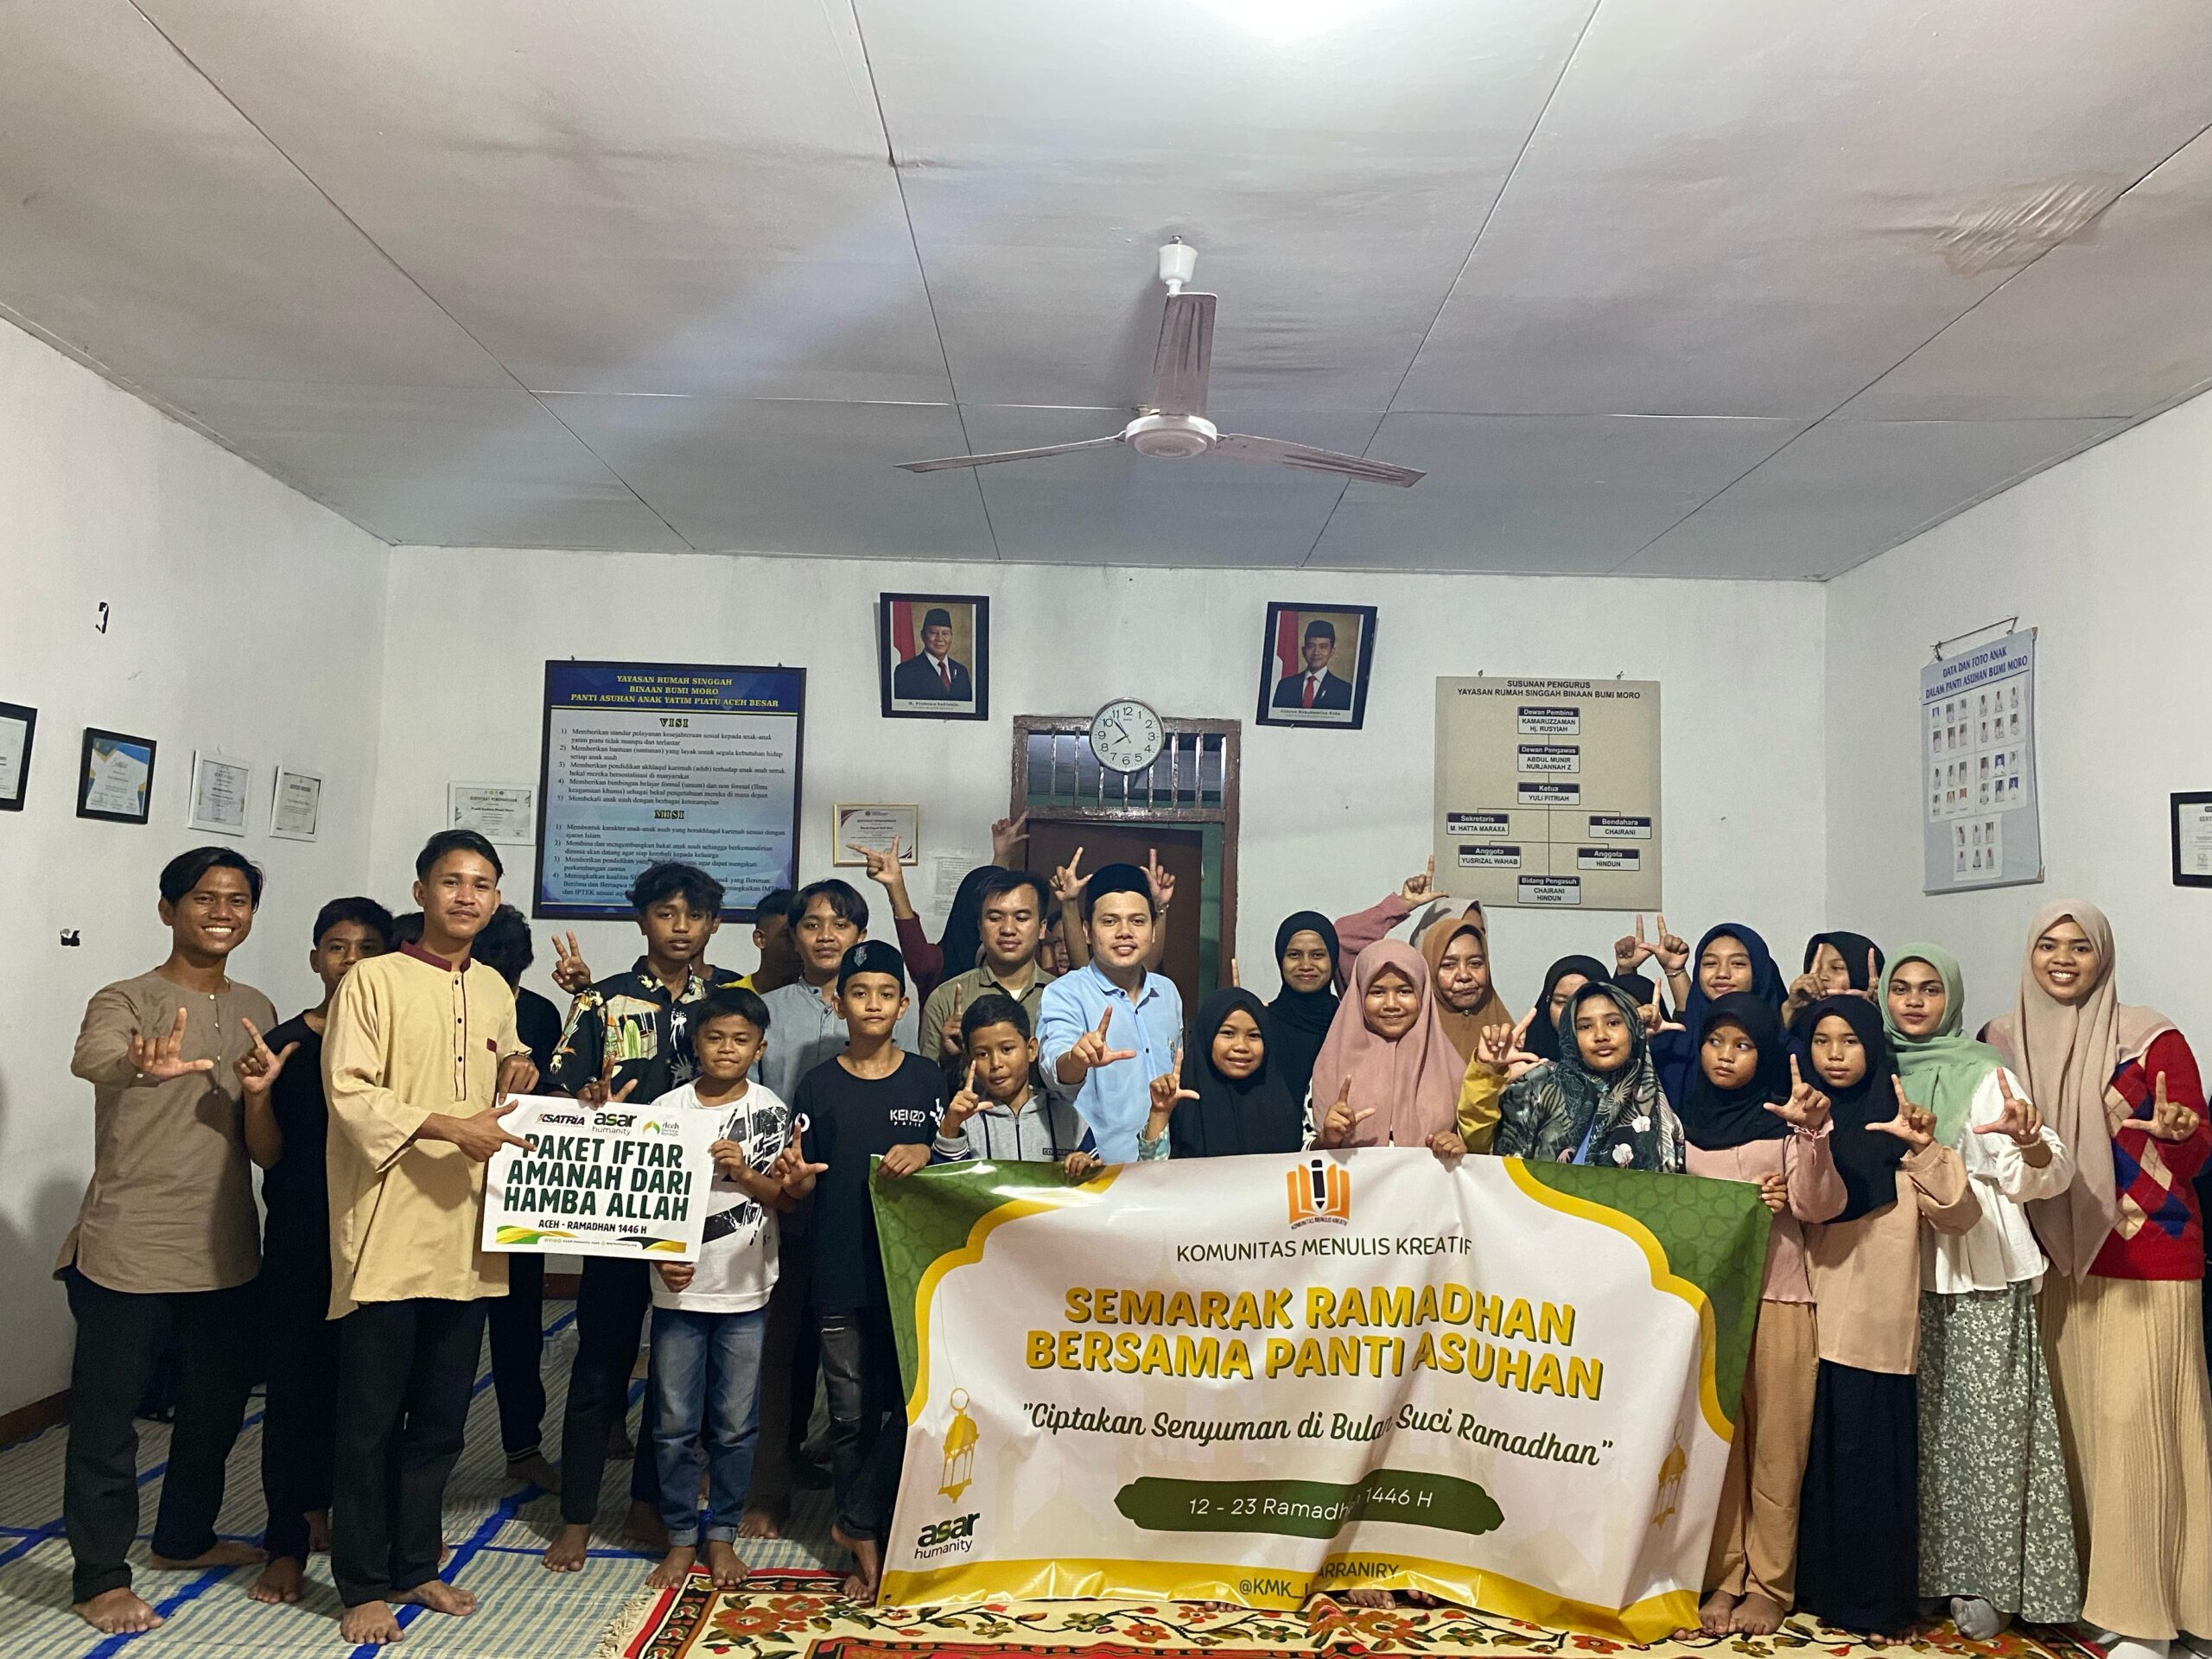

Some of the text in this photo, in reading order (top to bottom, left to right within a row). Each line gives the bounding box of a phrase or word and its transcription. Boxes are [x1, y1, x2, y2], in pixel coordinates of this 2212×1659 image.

[1942, 646, 2007, 678] DATA DAN FOTO ANAK
[1925, 655, 2028, 699] DALAM PANTI ASUHAN BUMI MORO
[629, 685, 663, 694] BINAAN
[1113, 709, 1119, 719] 11
[1123, 707, 1133, 715] 12
[659, 718, 689, 728] VISI
[1103, 719, 1113, 728] 10
[1146, 720, 1152, 728] 2
[1098, 731, 1106, 740] 9
[1102, 743, 1109, 752] 8
[1122, 756, 1130, 765] 6
[639, 779, 660, 788] belajar
[654, 810, 684, 820] MISI
[594, 1112, 637, 1128] asar
[890, 1109, 925, 1122] KENZO
[592, 1126, 632, 1136] humanity
[522, 1134, 683, 1168] PAKET IFTAR
[506, 1160, 692, 1195] AMANAH DARI
[504, 1186, 689, 1222] HAMBA ALLAH
[538, 1220, 559, 1229] ACEH
[567, 1221, 616, 1232] RAMADHAN
[618, 1224, 639, 1234] 1446
[1178, 1236, 1472, 1262] KOMUNITAS MENULIS KREATIF
[1065, 1282, 1576, 1346] SEMARAK RAMADHAN
[1026, 1330, 1604, 1401] BERSAMA PANTI ASUHAN
[1023, 1403, 1613, 1466] "Ciptakan Senyuman di Bulan Suci Ramadhan"
[1190, 1498, 1210, 1514] 12
[1230, 1498, 1257, 1515] 23
[1366, 1487, 1410, 1505] 1446
[1417, 1491, 1433, 1508] H
[918, 1513, 980, 1547] asar
[914, 1539, 972, 1559] humanity
